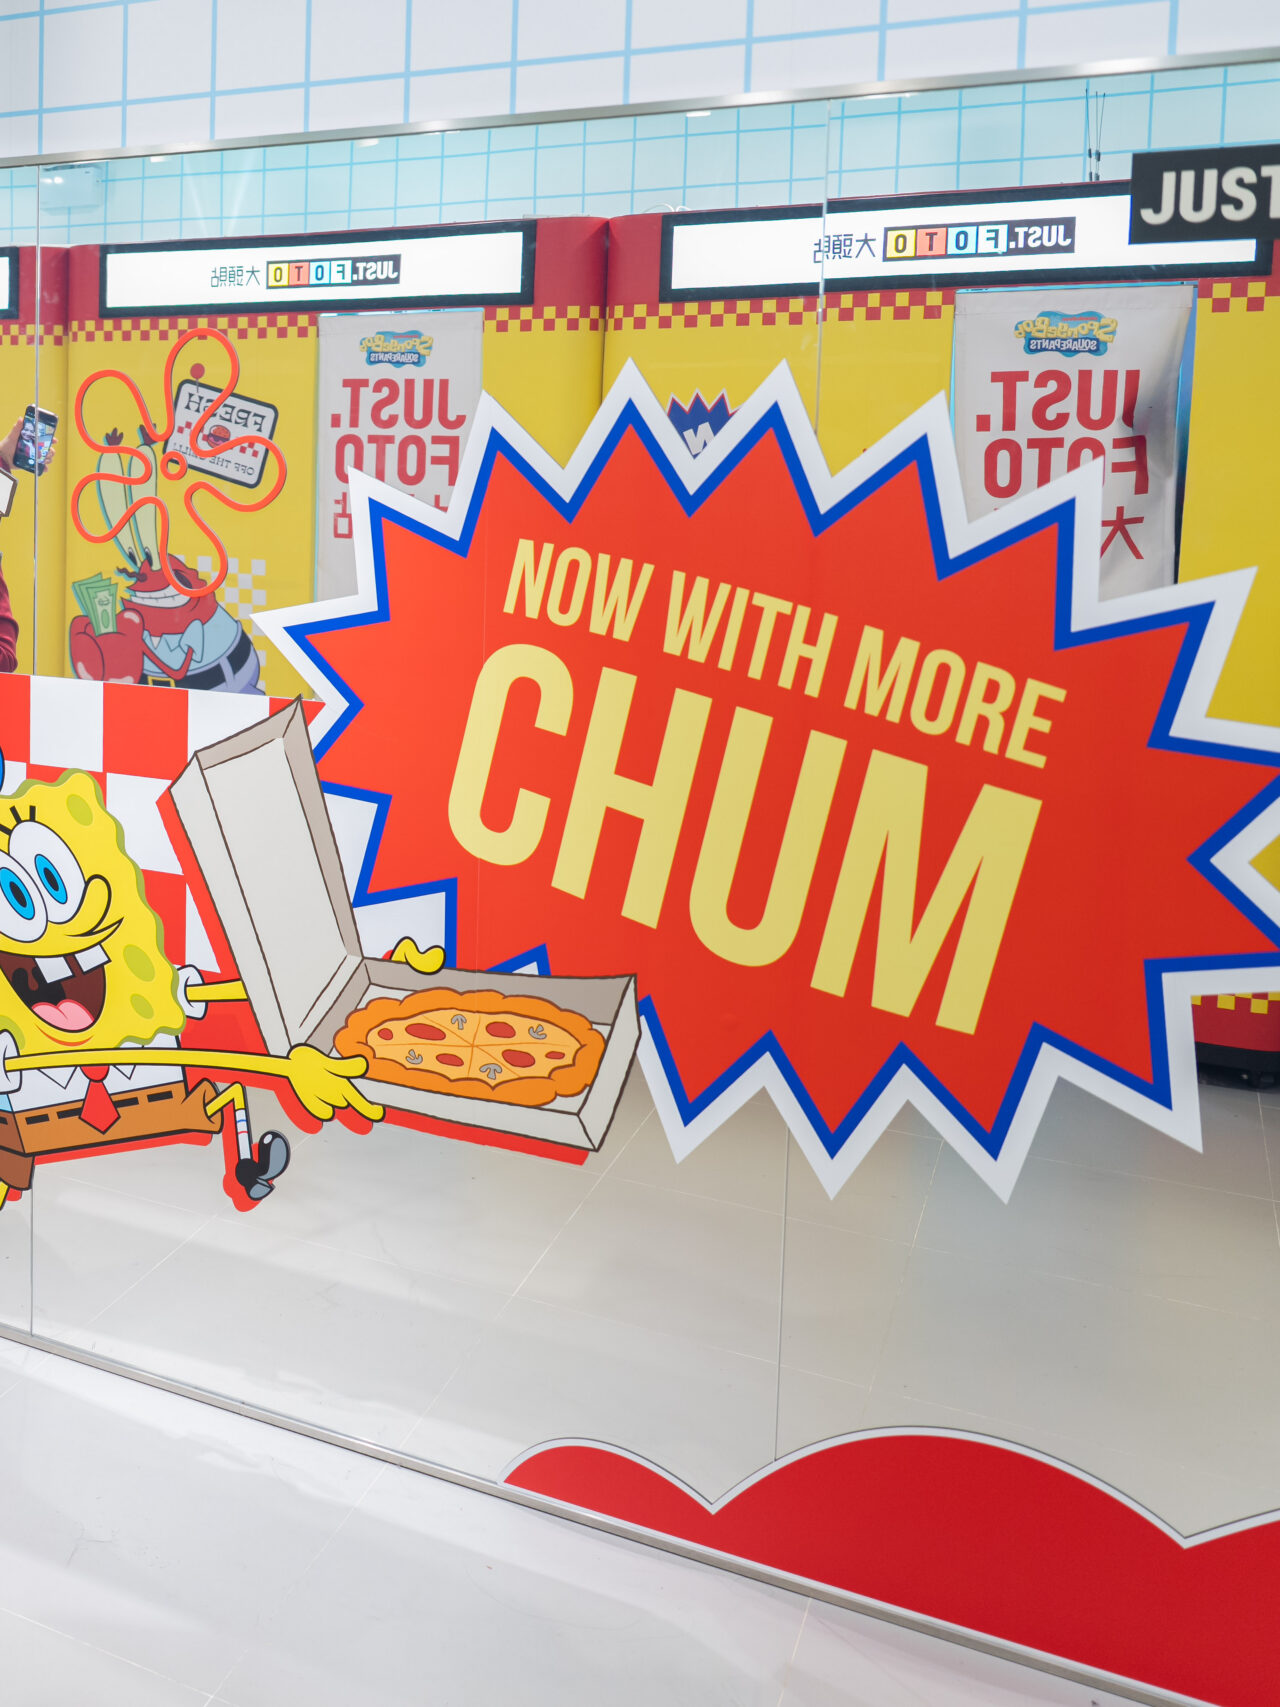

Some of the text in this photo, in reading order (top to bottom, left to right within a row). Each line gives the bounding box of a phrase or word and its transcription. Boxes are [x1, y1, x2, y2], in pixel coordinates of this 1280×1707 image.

[503, 538, 1067, 769] NOW WITH MORE
[447, 643, 1043, 1035] CHUM
